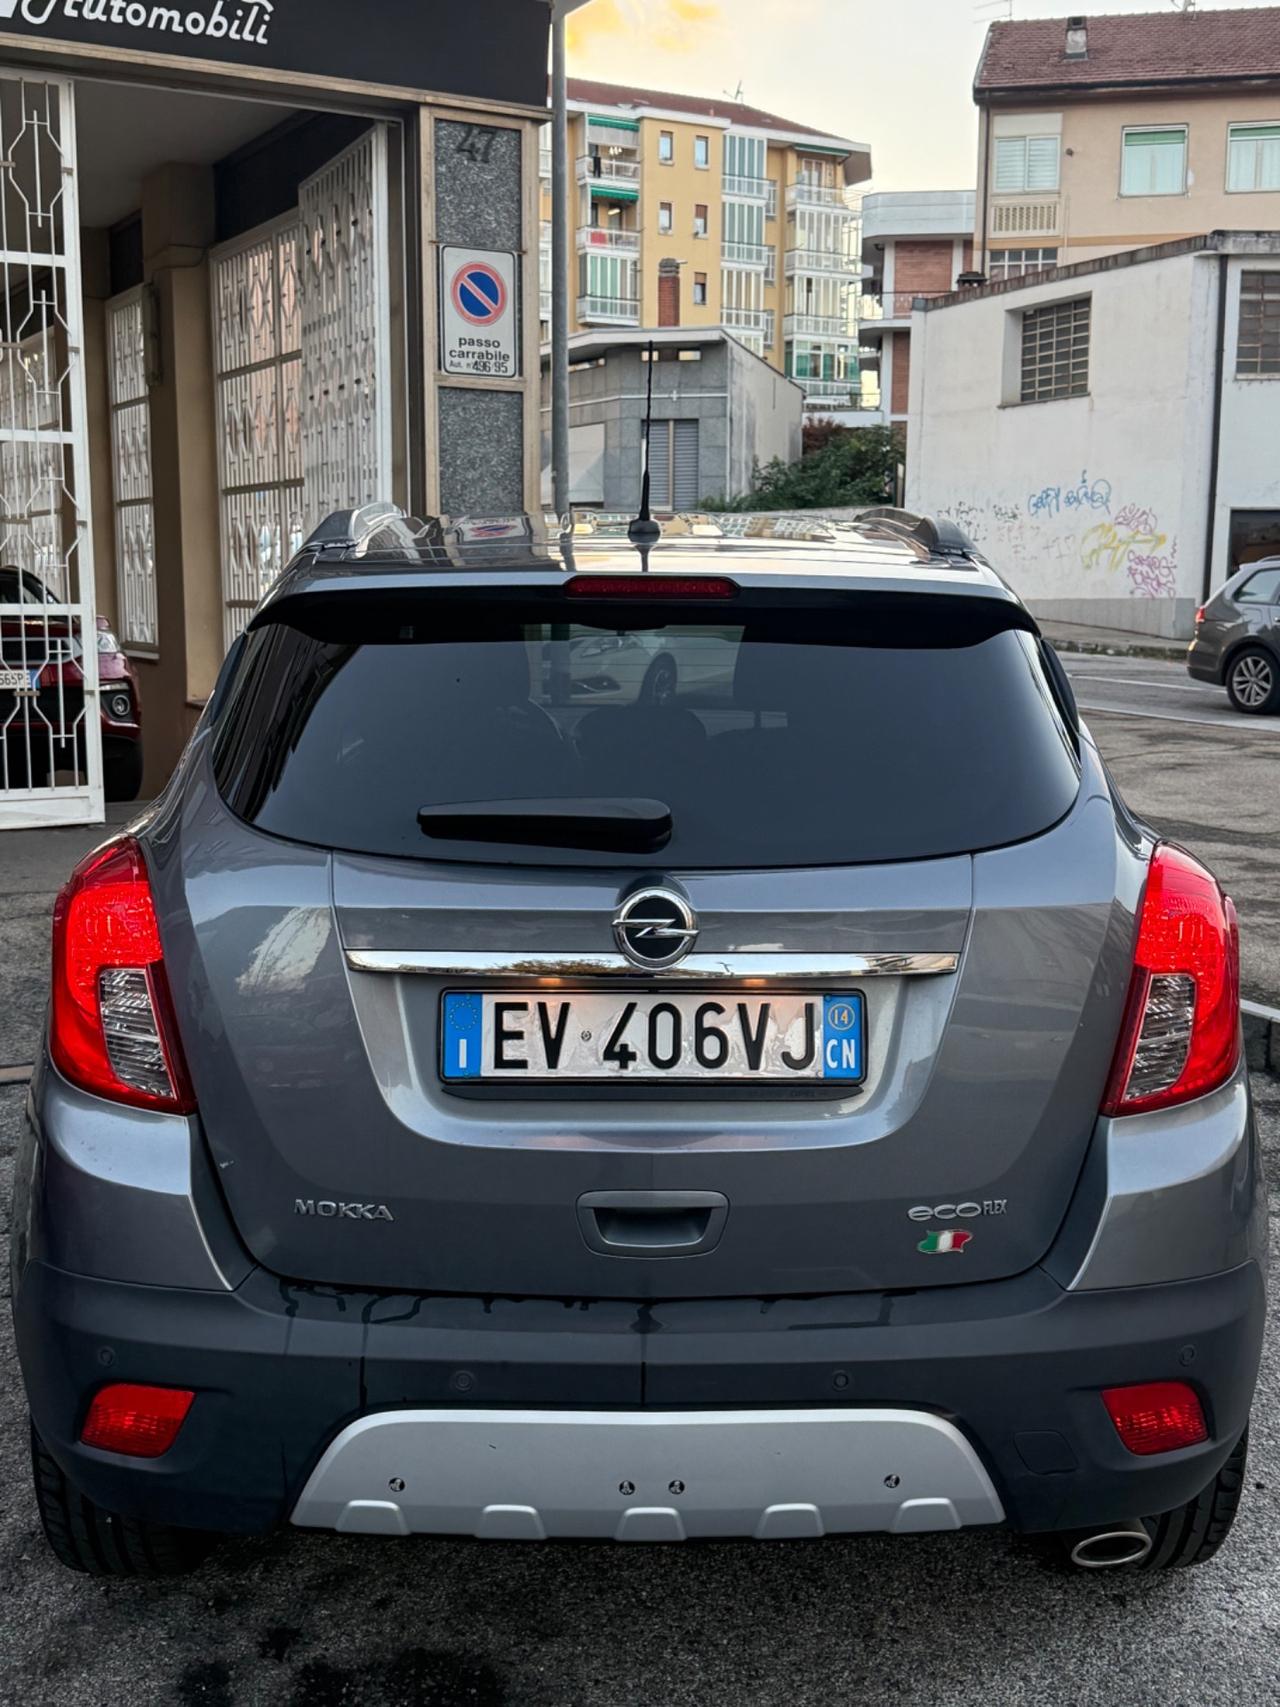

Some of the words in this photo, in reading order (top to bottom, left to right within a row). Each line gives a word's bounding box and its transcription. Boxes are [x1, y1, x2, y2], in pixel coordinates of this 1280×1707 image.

[458, 337, 501, 349] passo
[449, 349, 510, 362] carrabile
[834, 1008, 849, 1025] 14
[494, 1001, 569, 1070] EV
[603, 1001, 815, 1070] 406VJ
[826, 1038, 856, 1069] CN
[294, 1199, 394, 1221] MOKKA
